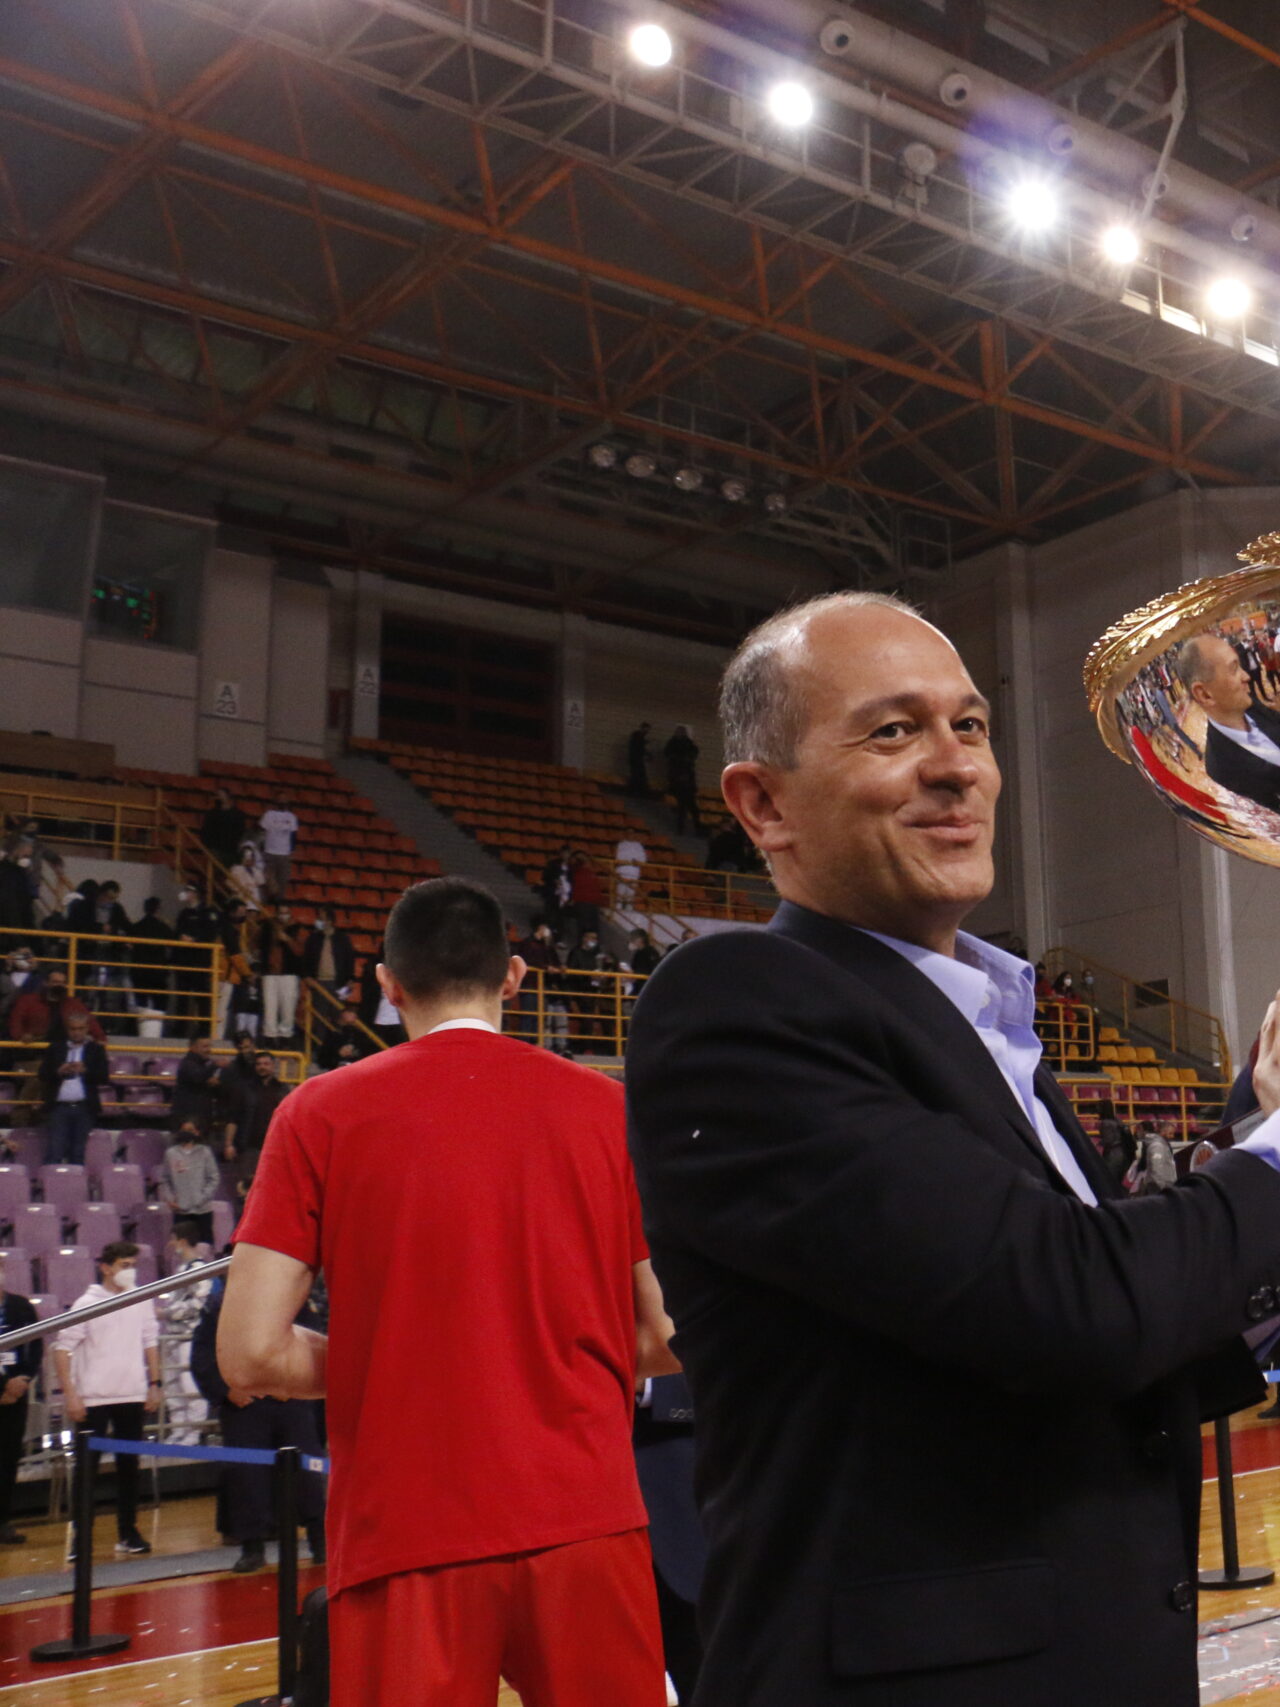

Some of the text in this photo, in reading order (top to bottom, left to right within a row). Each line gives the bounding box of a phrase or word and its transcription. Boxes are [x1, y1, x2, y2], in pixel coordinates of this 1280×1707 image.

[363, 668, 375, 680] A
[220, 684, 235, 699] A
[216, 699, 237, 715] 23
